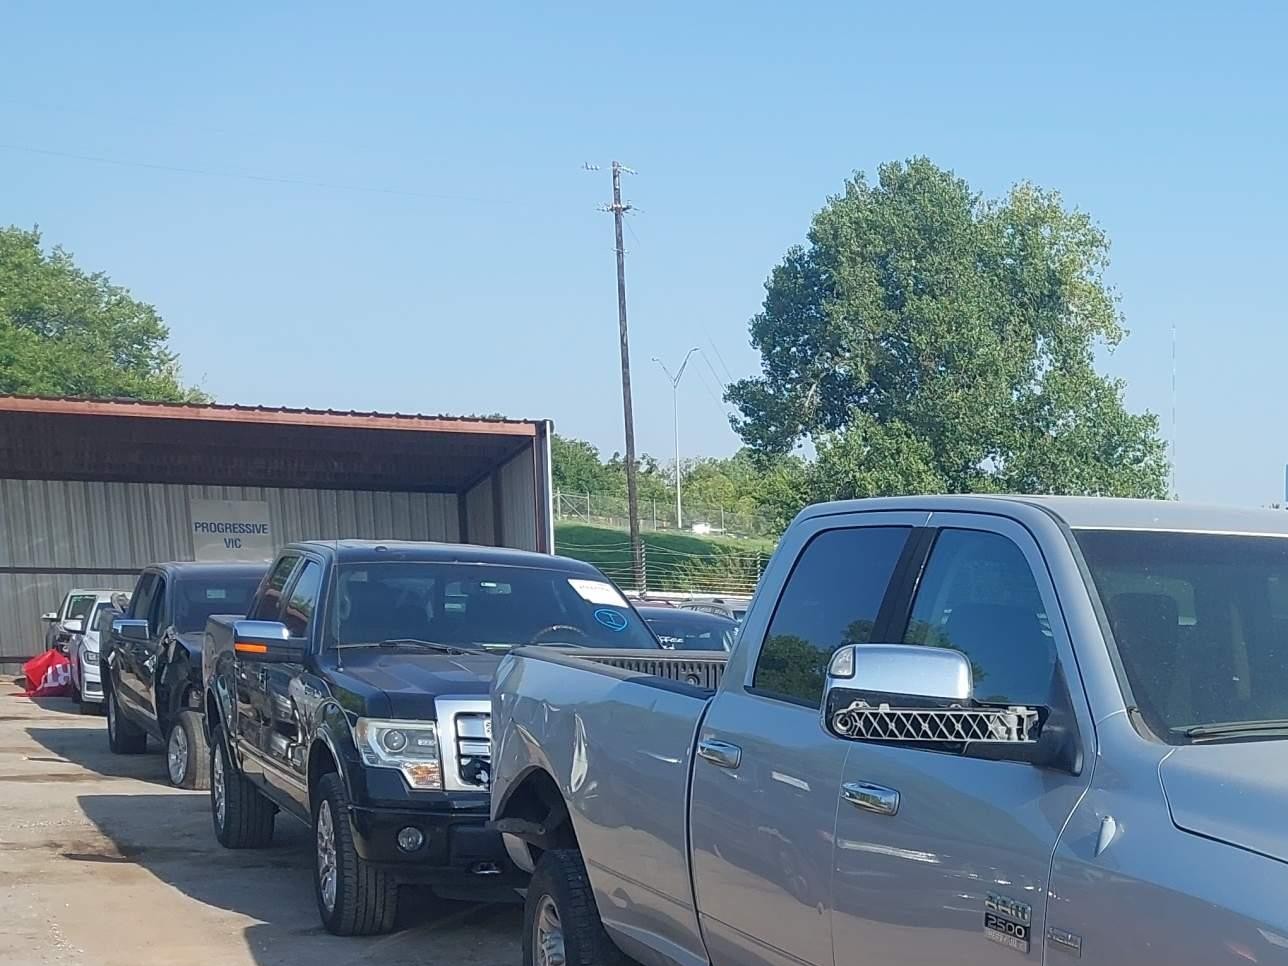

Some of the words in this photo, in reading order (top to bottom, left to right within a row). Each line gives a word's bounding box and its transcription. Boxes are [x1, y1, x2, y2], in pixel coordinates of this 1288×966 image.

[194, 522, 269, 535] PROGRESSIVE
[223, 538, 242, 549] VIC
[987, 915, 1025, 939] 2500
